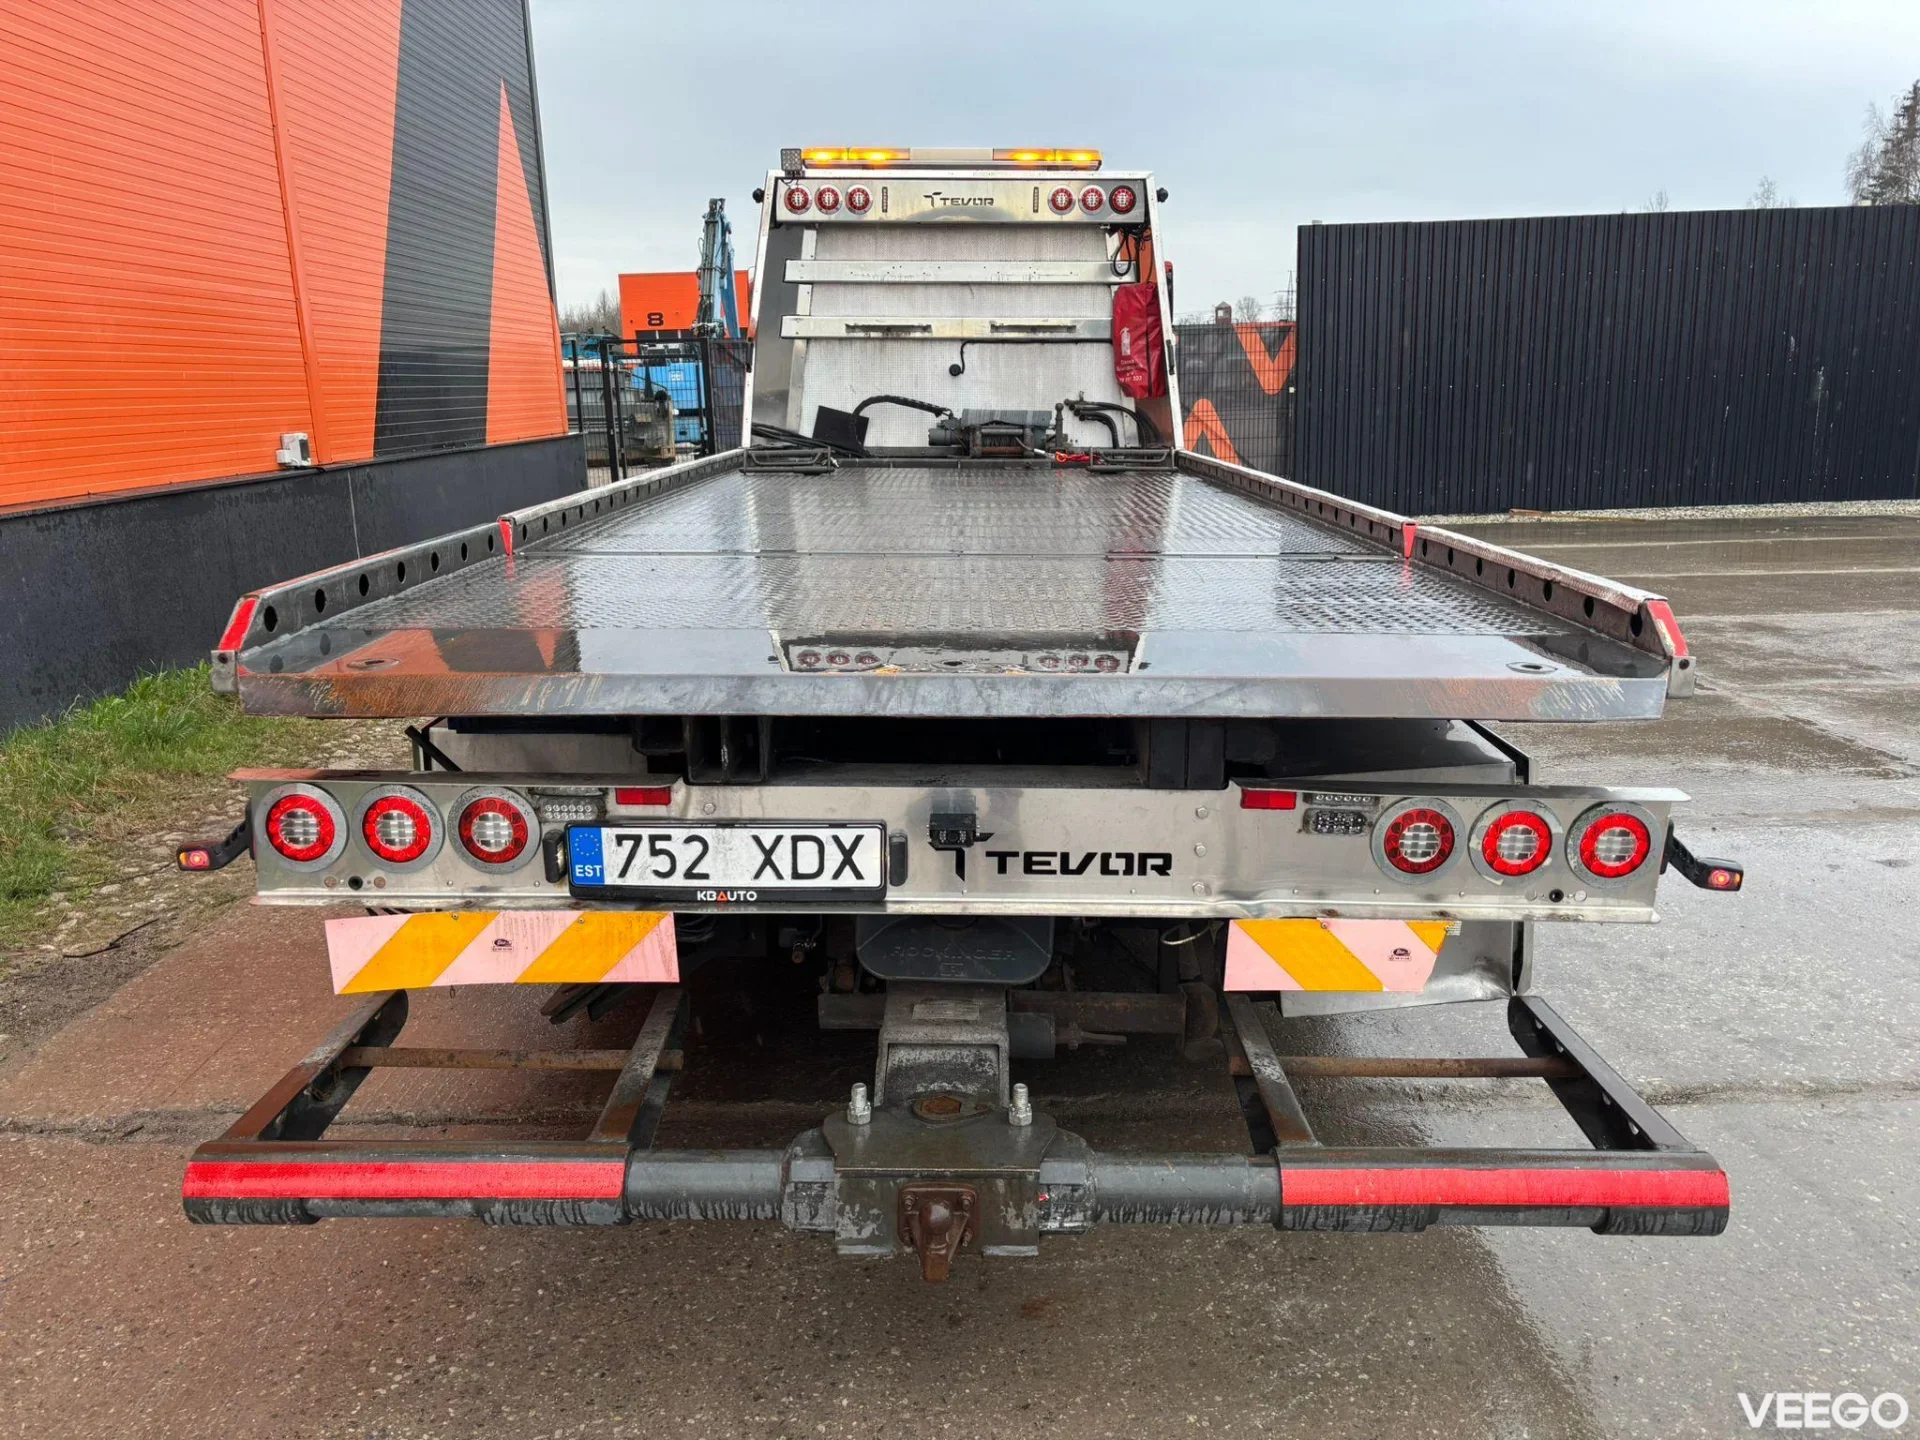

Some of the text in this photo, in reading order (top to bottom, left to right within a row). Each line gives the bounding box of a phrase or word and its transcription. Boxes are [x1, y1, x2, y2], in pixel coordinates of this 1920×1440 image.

[647, 312, 664, 326] 8
[615, 834, 865, 880] 752 XDX
[985, 851, 1173, 877] TEVOR
[576, 864, 602, 877] EST
[697, 890, 758, 902] KBAUTO
